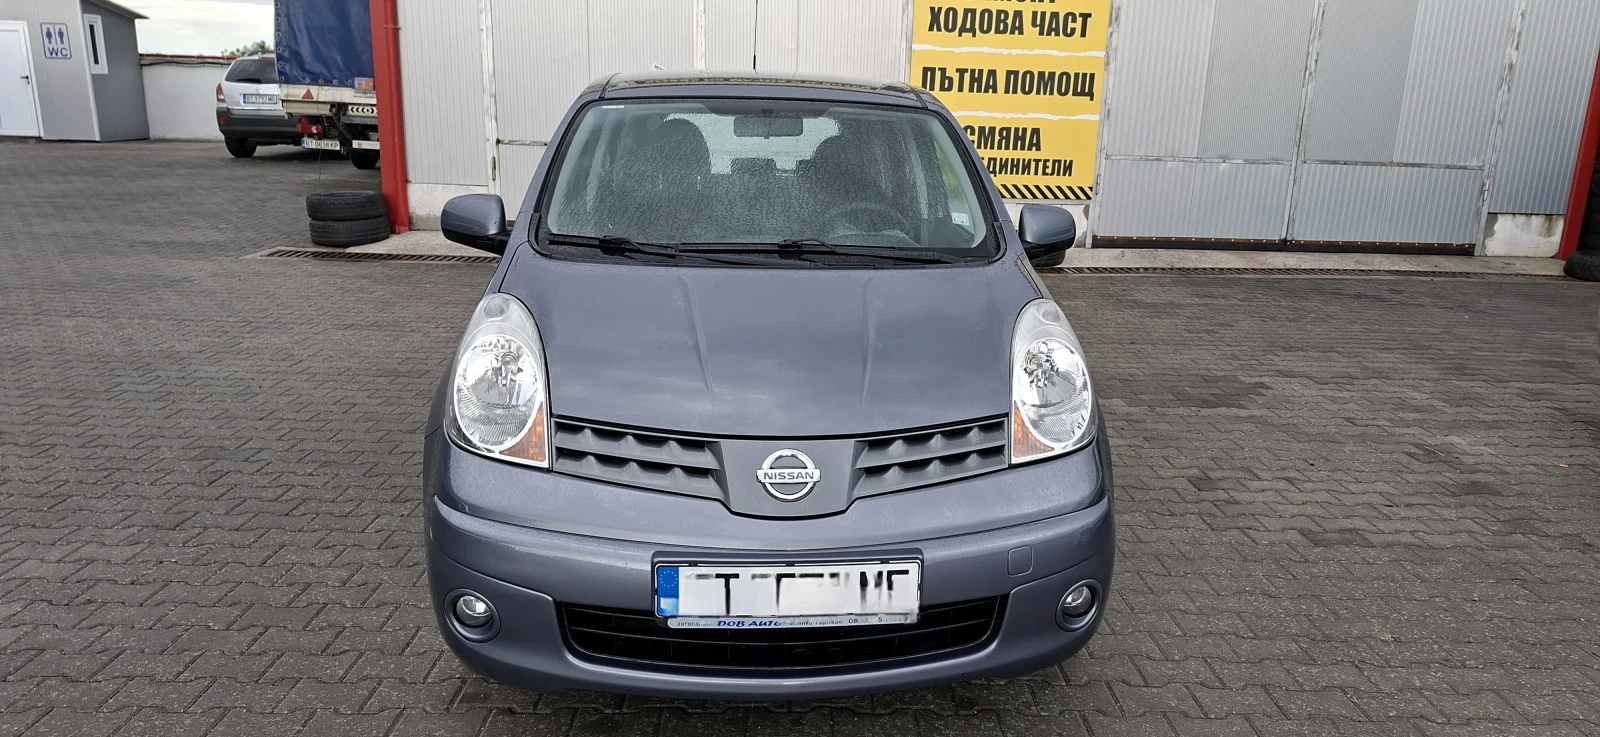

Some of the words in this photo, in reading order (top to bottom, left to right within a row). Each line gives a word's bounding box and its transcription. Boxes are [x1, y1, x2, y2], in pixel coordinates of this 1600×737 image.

[928, 6, 1024, 37] ХОДОВА
[1030, 11, 1092, 38] ЧАСТ
[47, 47, 68, 57] WC
[921, 67, 998, 94] ПЪТНА
[1004, 70, 1095, 101] ПОМОЩ
[964, 125, 1041, 151] СМЯНА
[981, 157, 1073, 177] ДИНИТЕЛИ
[763, 471, 814, 480] NISSAN
[717, 620, 746, 628] DOB
